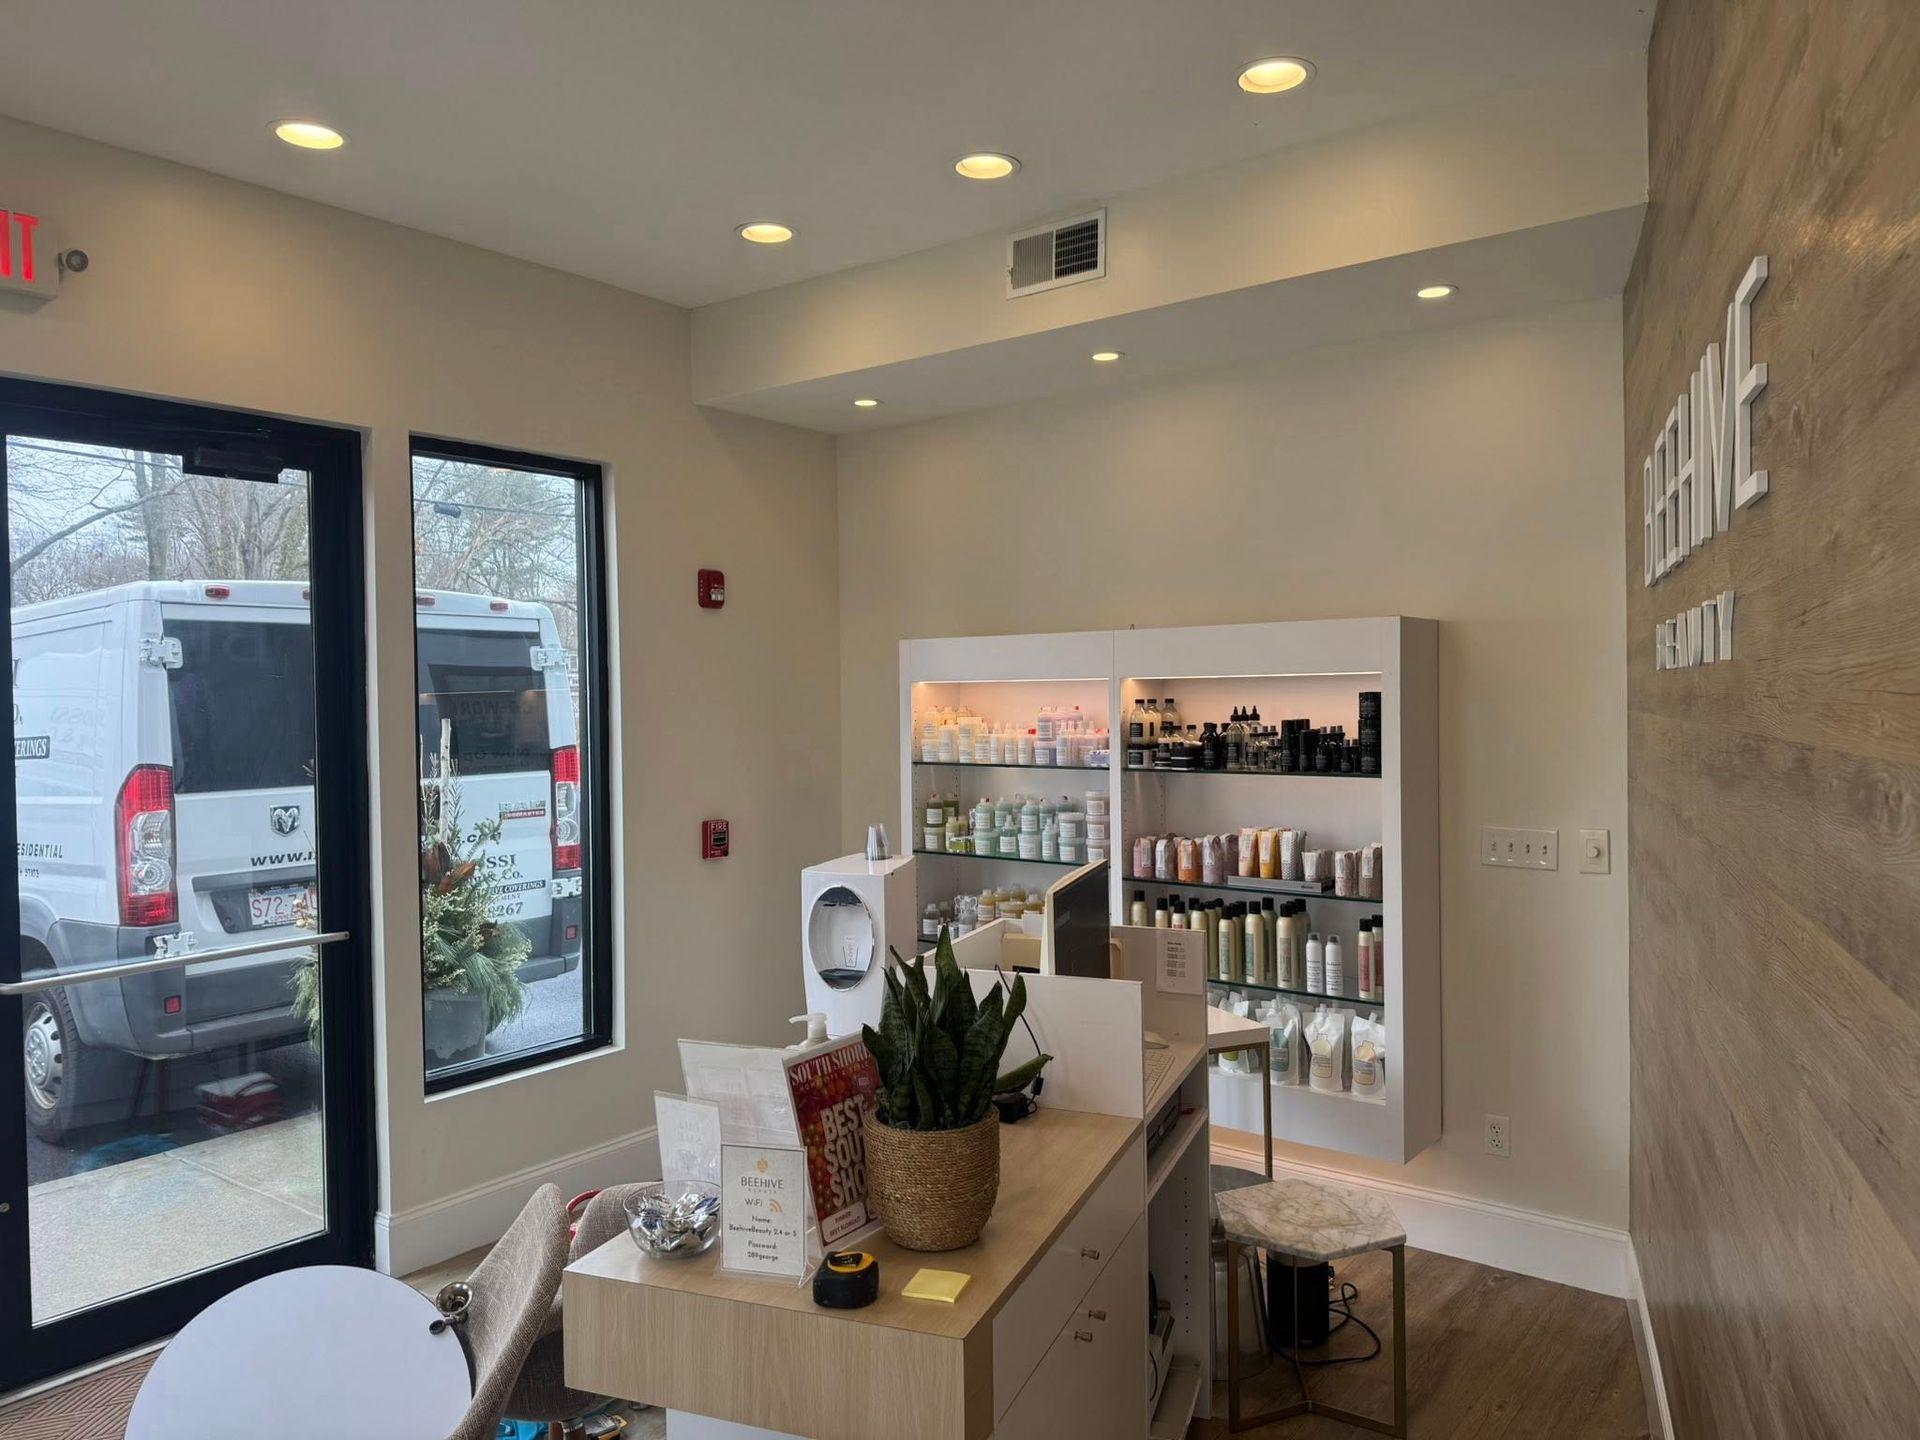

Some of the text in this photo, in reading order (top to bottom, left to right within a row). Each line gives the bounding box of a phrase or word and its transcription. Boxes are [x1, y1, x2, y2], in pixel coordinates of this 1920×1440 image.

[1644, 255, 1769, 588] BEEHIVE
[1656, 590, 1736, 671] BEAUTY
[15, 738, 48, 757] ERINGS
[711, 823, 728, 831] FIRE
[17, 843, 63, 858] ESIDENTIAL
[486, 854, 518, 870] SSI
[503, 881, 545, 893] COVERINGS
[789, 1055, 832, 1086] SOUTH
[820, 1094, 865, 1141] BEST
[824, 1130, 866, 1174] SOU
[741, 1177, 785, 1190] BEEHIVE
[830, 1163, 867, 1207] SHO
[744, 1197, 763, 1207] WiFi
